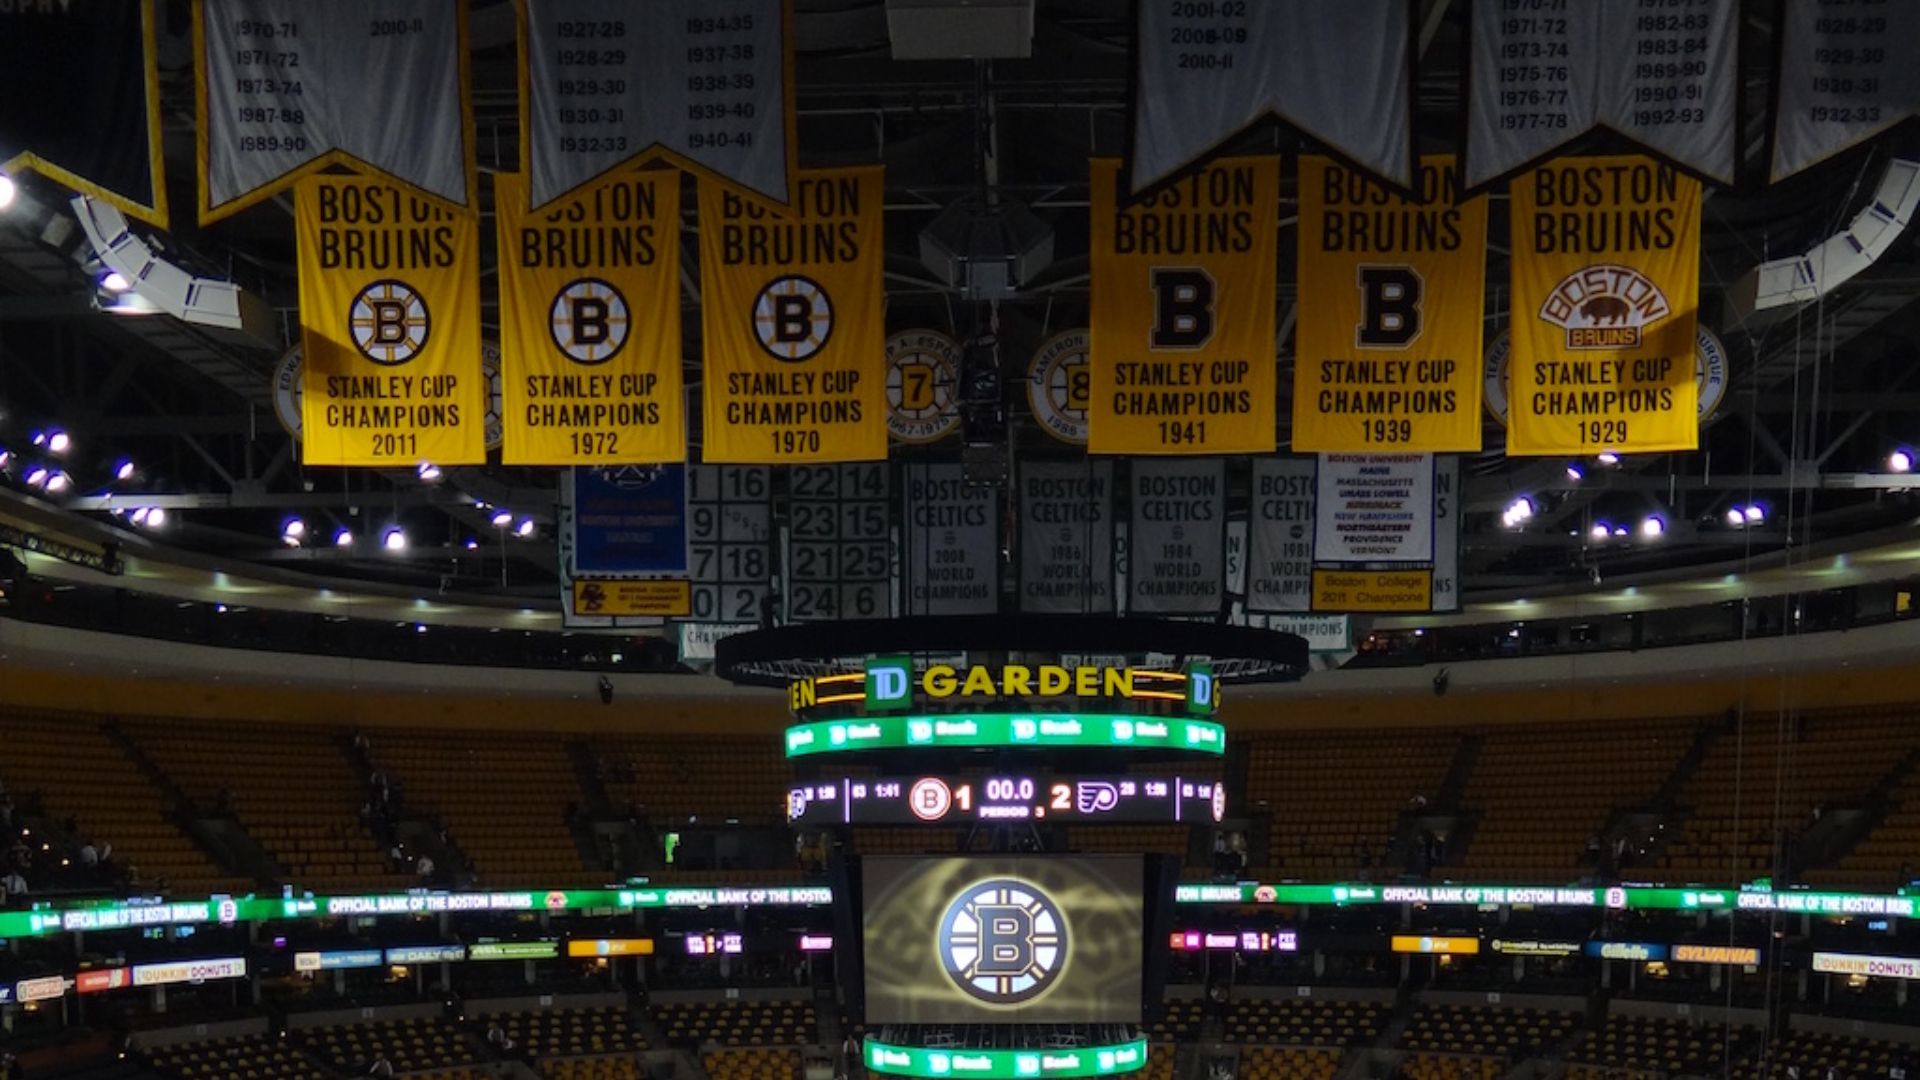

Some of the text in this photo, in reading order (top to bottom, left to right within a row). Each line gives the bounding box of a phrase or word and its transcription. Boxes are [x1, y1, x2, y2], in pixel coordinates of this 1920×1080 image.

[1171, 1, 1245, 18] 2001-02
[236, 20, 297, 38] 1970-71
[372, 19, 422, 37] 2010-11
[558, 21, 625, 38] 1927-28
[687, 15, 753, 34] 1934-35
[1502, 19, 1567, 35] 1971-72
[1638, 15, 1709, 31] 1982-83
[688, 45, 753, 63] 1937-38
[1502, 43, 1568, 58] 1973-74
[1638, 38, 1706, 55] 1983-84
[237, 51, 298, 66] 1971-72
[558, 50, 626, 65] 1928-29
[1179, 53, 1232, 69] 2010-11
[1501, 66, 1567, 82] 1975-76
[1636, 61, 1706, 79] 1989-90
[237, 80, 302, 95] 1973-74
[559, 80, 625, 95] 1929-30
[688, 74, 754, 91] 1938-39
[1501, 90, 1567, 106] 1976-77
[1635, 85, 1702, 102] 1990-91
[239, 109, 304, 125] 1987-88
[560, 109, 623, 124] 1930-31
[689, 103, 754, 120] 1939-40
[1501, 113, 1567, 130] 1977-78
[1634, 109, 1704, 125] 1992-93
[241, 137, 305, 151] 1989-90
[561, 136, 626, 152] 1932-33
[689, 132, 752, 148] 1940-41
[1535, 165, 1677, 206] BOSTON
[1116, 211, 1252, 254] BRUINS
[1324, 210, 1461, 252] BRUINS
[1534, 208, 1674, 253] BRUINS
[321, 227, 454, 269] BRUINS
[522, 225, 655, 268] BRUINS
[724, 221, 858, 265] BRUINS
[1545, 268, 1665, 322] BOSTON
[1151, 268, 1216, 349] B
[1356, 263, 1424, 350] B
[373, 302, 406, 343] B
[574, 299, 608, 344] B
[776, 296, 811, 341] B
[1572, 329, 1636, 345] BRUINS
[1035, 335, 1083, 385] CAMERON
[1115, 361, 1249, 385] STANLEY CUP
[1321, 359, 1455, 384] STANLEY CUP
[1535, 360, 1625, 385] STANLEY
[1633, 359, 1672, 382] CUP
[327, 375, 457, 398] STANLEY CUP
[527, 374, 657, 398] STANLEY CUP
[728, 371, 860, 396] STANLEY CUP
[908, 373, 927, 402] 7
[1072, 371, 1089, 401] 8
[1114, 391, 1250, 415] CHAMPIONS
[1319, 389, 1456, 413] CHAMPIONS
[1533, 388, 1672, 415] CHAMPIONS
[326, 404, 460, 428] CHAMPIONS
[527, 403, 659, 427] CHAMPIONS
[727, 400, 862, 425] CHAMPIONS
[1159, 421, 1205, 444] 1941
[1362, 419, 1411, 442] 1939
[1578, 420, 1627, 443] 1929
[372, 434, 416, 456] 2011
[571, 432, 618, 455] 1972
[772, 430, 820, 453] 1970
[728, 469, 764, 497] 16
[794, 467, 835, 495] 22
[847, 467, 884, 495] 14
[1028, 478, 1104, 498] BOSTON
[1139, 476, 1216, 496] BOSTON
[794, 507, 834, 535] 23
[848, 507, 884, 535] 15
[915, 505, 986, 527] CELTICS
[1031, 503, 1101, 523] CELTICS
[1143, 501, 1213, 522] CELTICS
[796, 548, 832, 576] 21
[845, 547, 886, 576] 25
[936, 551, 965, 563] 2008
[1163, 544, 1192, 559] 1984
[728, 549, 763, 578] 18
[1153, 563, 1201, 577] WORLD
[928, 568, 974, 581] WORLD
[914, 585, 988, 600] CHAMPIONS
[1138, 581, 1216, 596] CHAMPIONS
[736, 590, 755, 617] 2
[794, 587, 835, 616] 24
[856, 587, 874, 615] 6
[868, 664, 1133, 700] TD GARDEN
[875, 784, 899, 798] 1:41
[955, 785, 970, 810] 1
[987, 780, 1034, 800] 00.0
[1052, 784, 1071, 809] 2
[980, 806, 1029, 818] PERIOD
[329, 897, 377, 913] OFFICIAL
[378, 897, 409, 911] BANK
[410, 896, 425, 911] OF
[426, 896, 447, 910] THE
[448, 895, 488, 909] BOSTON
[666, 889, 790, 904] OFFICIAL BANK OF THE
[1201, 886, 1242, 902] BRUINS
[1383, 888, 1594, 902] OFFICIAL BANK OF THE BOSTON BRUINS
[1737, 893, 1884, 913] OFFICIAL BANK OF THE BOSTON
[975, 904, 1034, 976] B
[1675, 946, 1757, 965] SYLVANIA
[191, 964, 232, 978] DONUTS
[1869, 961, 1914, 975] DONUTS
